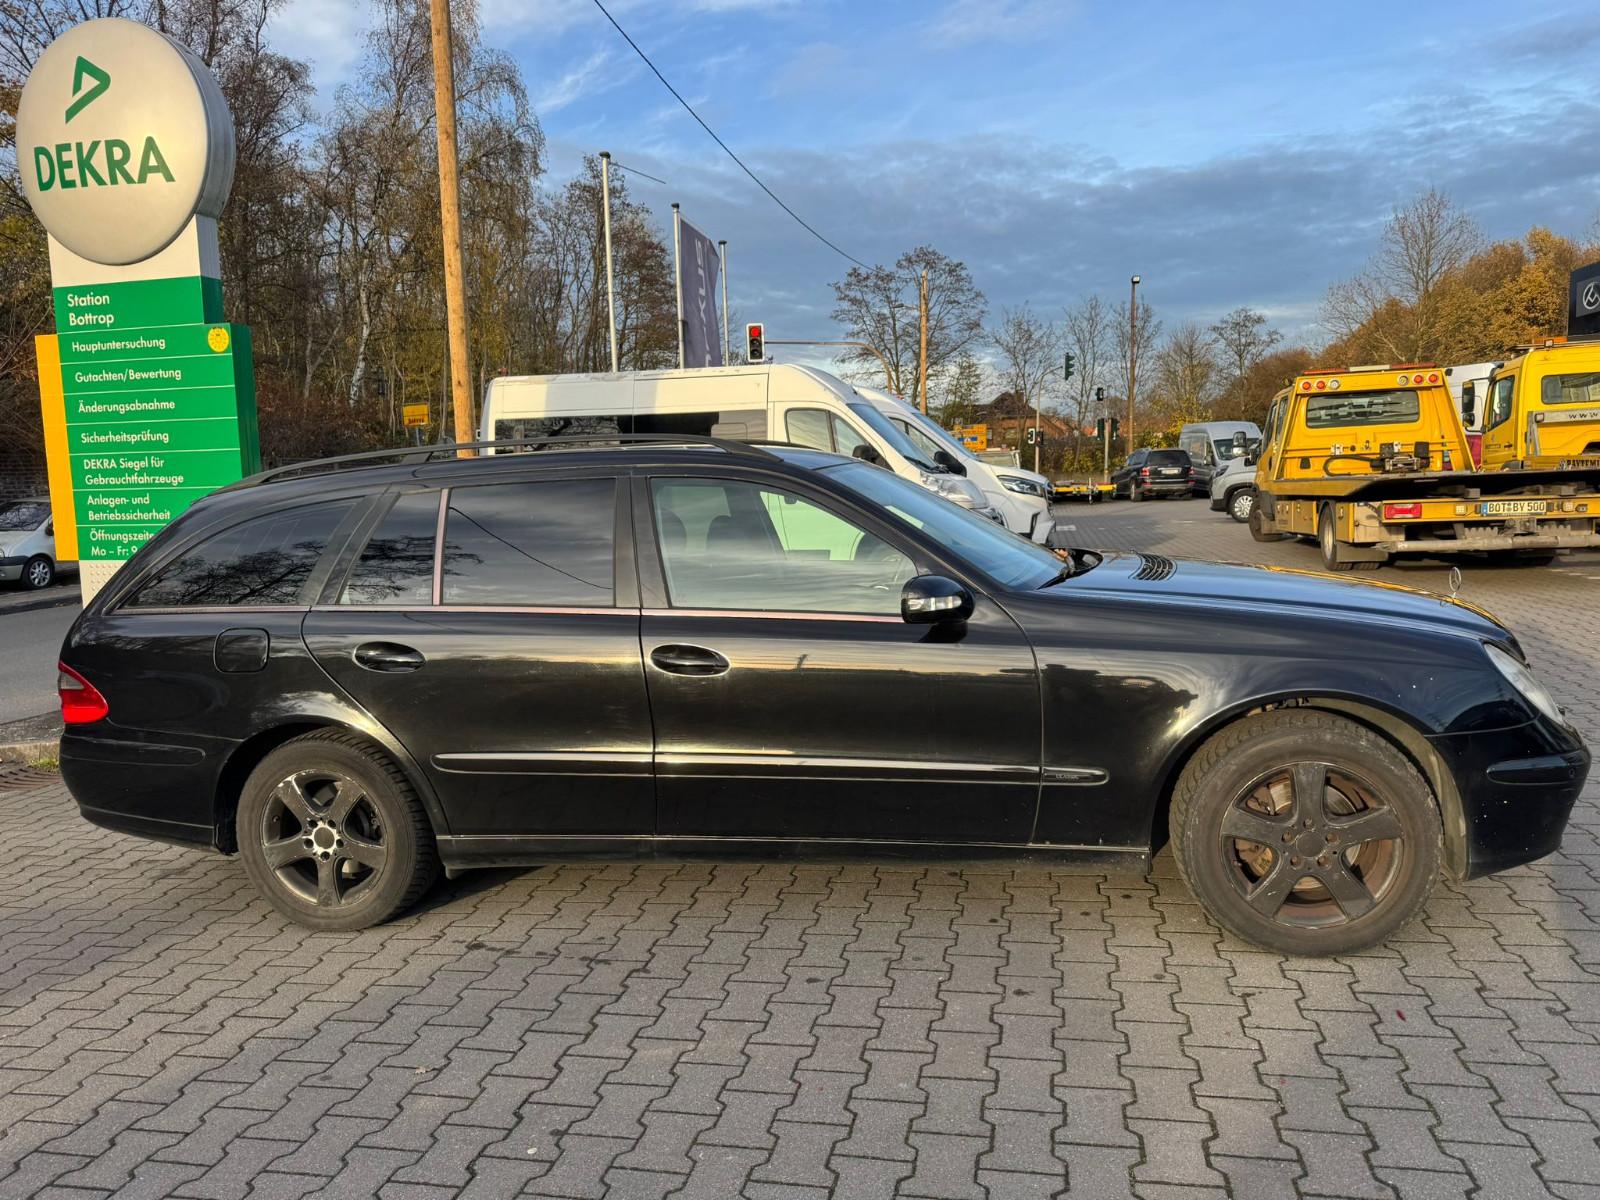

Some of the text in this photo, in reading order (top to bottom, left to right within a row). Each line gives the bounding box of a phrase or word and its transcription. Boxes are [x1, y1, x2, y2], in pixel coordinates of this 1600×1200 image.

[34, 136, 175, 192] DEKRA
[67, 291, 110, 307] Station
[69, 313, 114, 328] Bottrop
[72, 336, 166, 354] Hauptuntersuchung
[75, 368, 182, 383] Gutachten/Bewertung
[78, 399, 176, 414] Änderungsabnahme
[81, 430, 169, 445] Sicherheitsprüfung
[83, 456, 164, 471] DEKRA Siegel für
[85, 472, 184, 486] Gebrauchtfahrzeuge
[87, 492, 150, 508] Anlagen- und
[1488, 501, 1545, 512] BOT BY 500
[88, 508, 171, 521] Betriebssicherheit
[92, 545, 106, 557] Mo
[117, 545, 129, 556] Fr:
